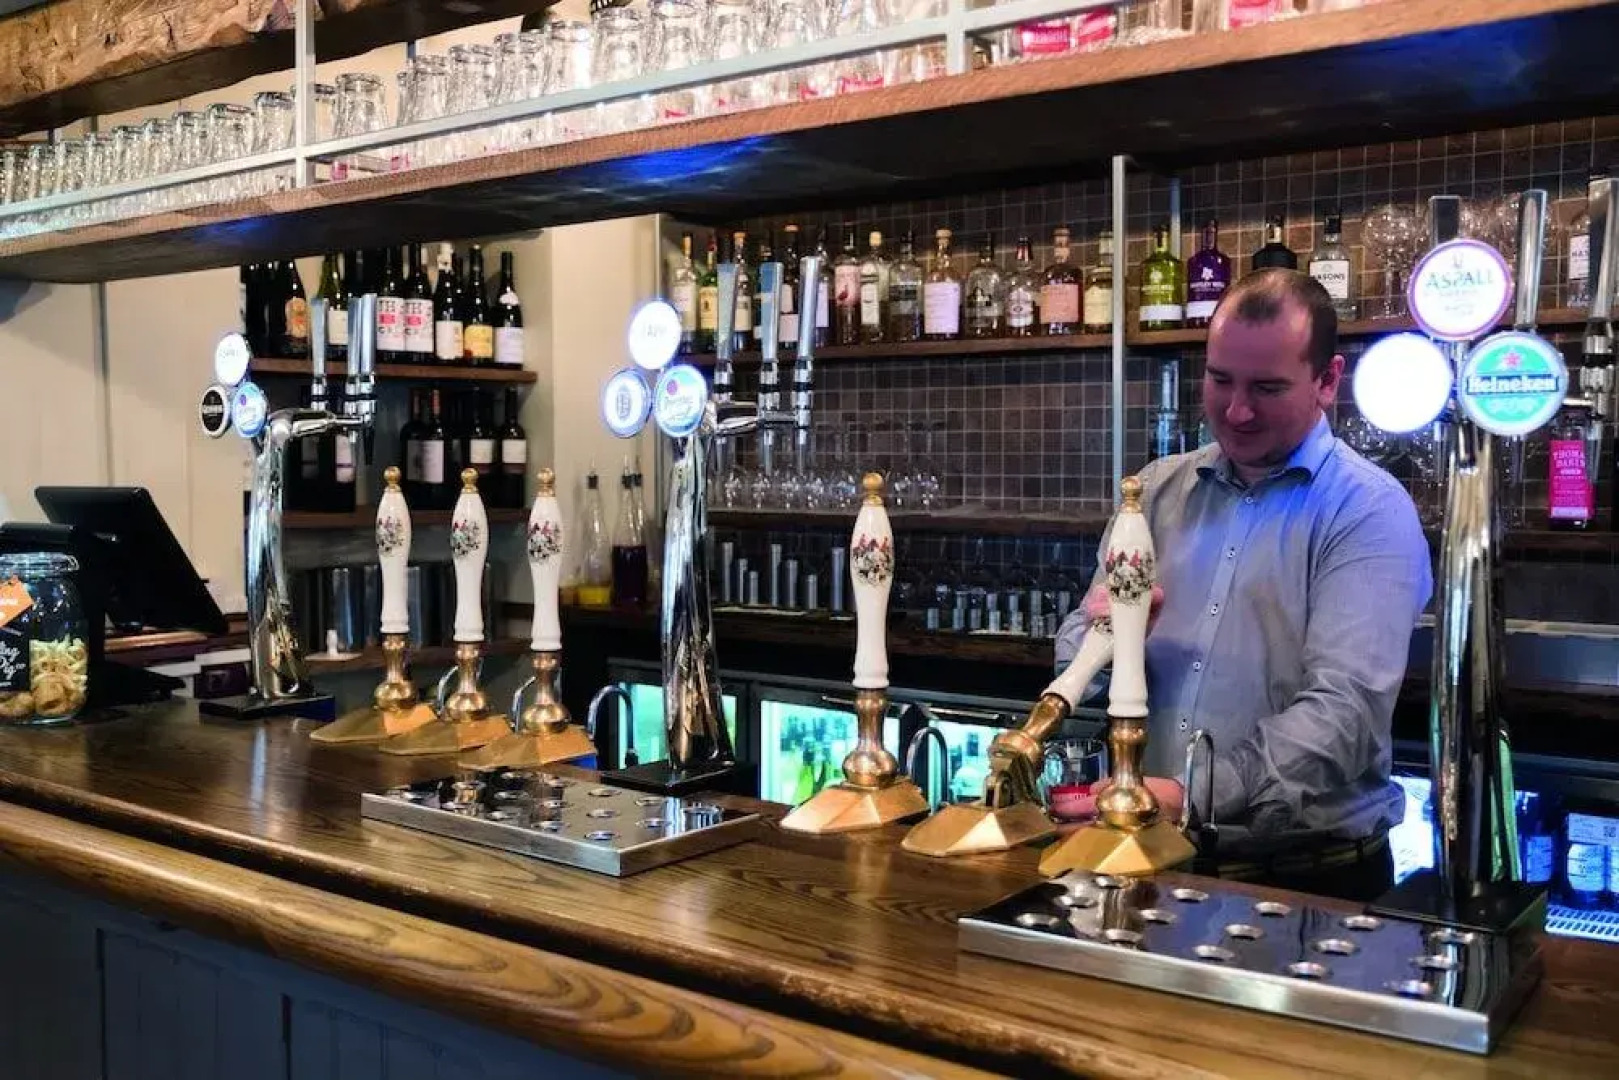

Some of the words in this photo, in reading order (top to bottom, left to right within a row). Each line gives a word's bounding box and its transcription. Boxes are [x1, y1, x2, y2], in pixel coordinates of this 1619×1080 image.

[1315, 272, 1346, 281] ASONS
[1425, 269, 1495, 289] ASPALL
[1468, 374, 1556, 393] Heineken
